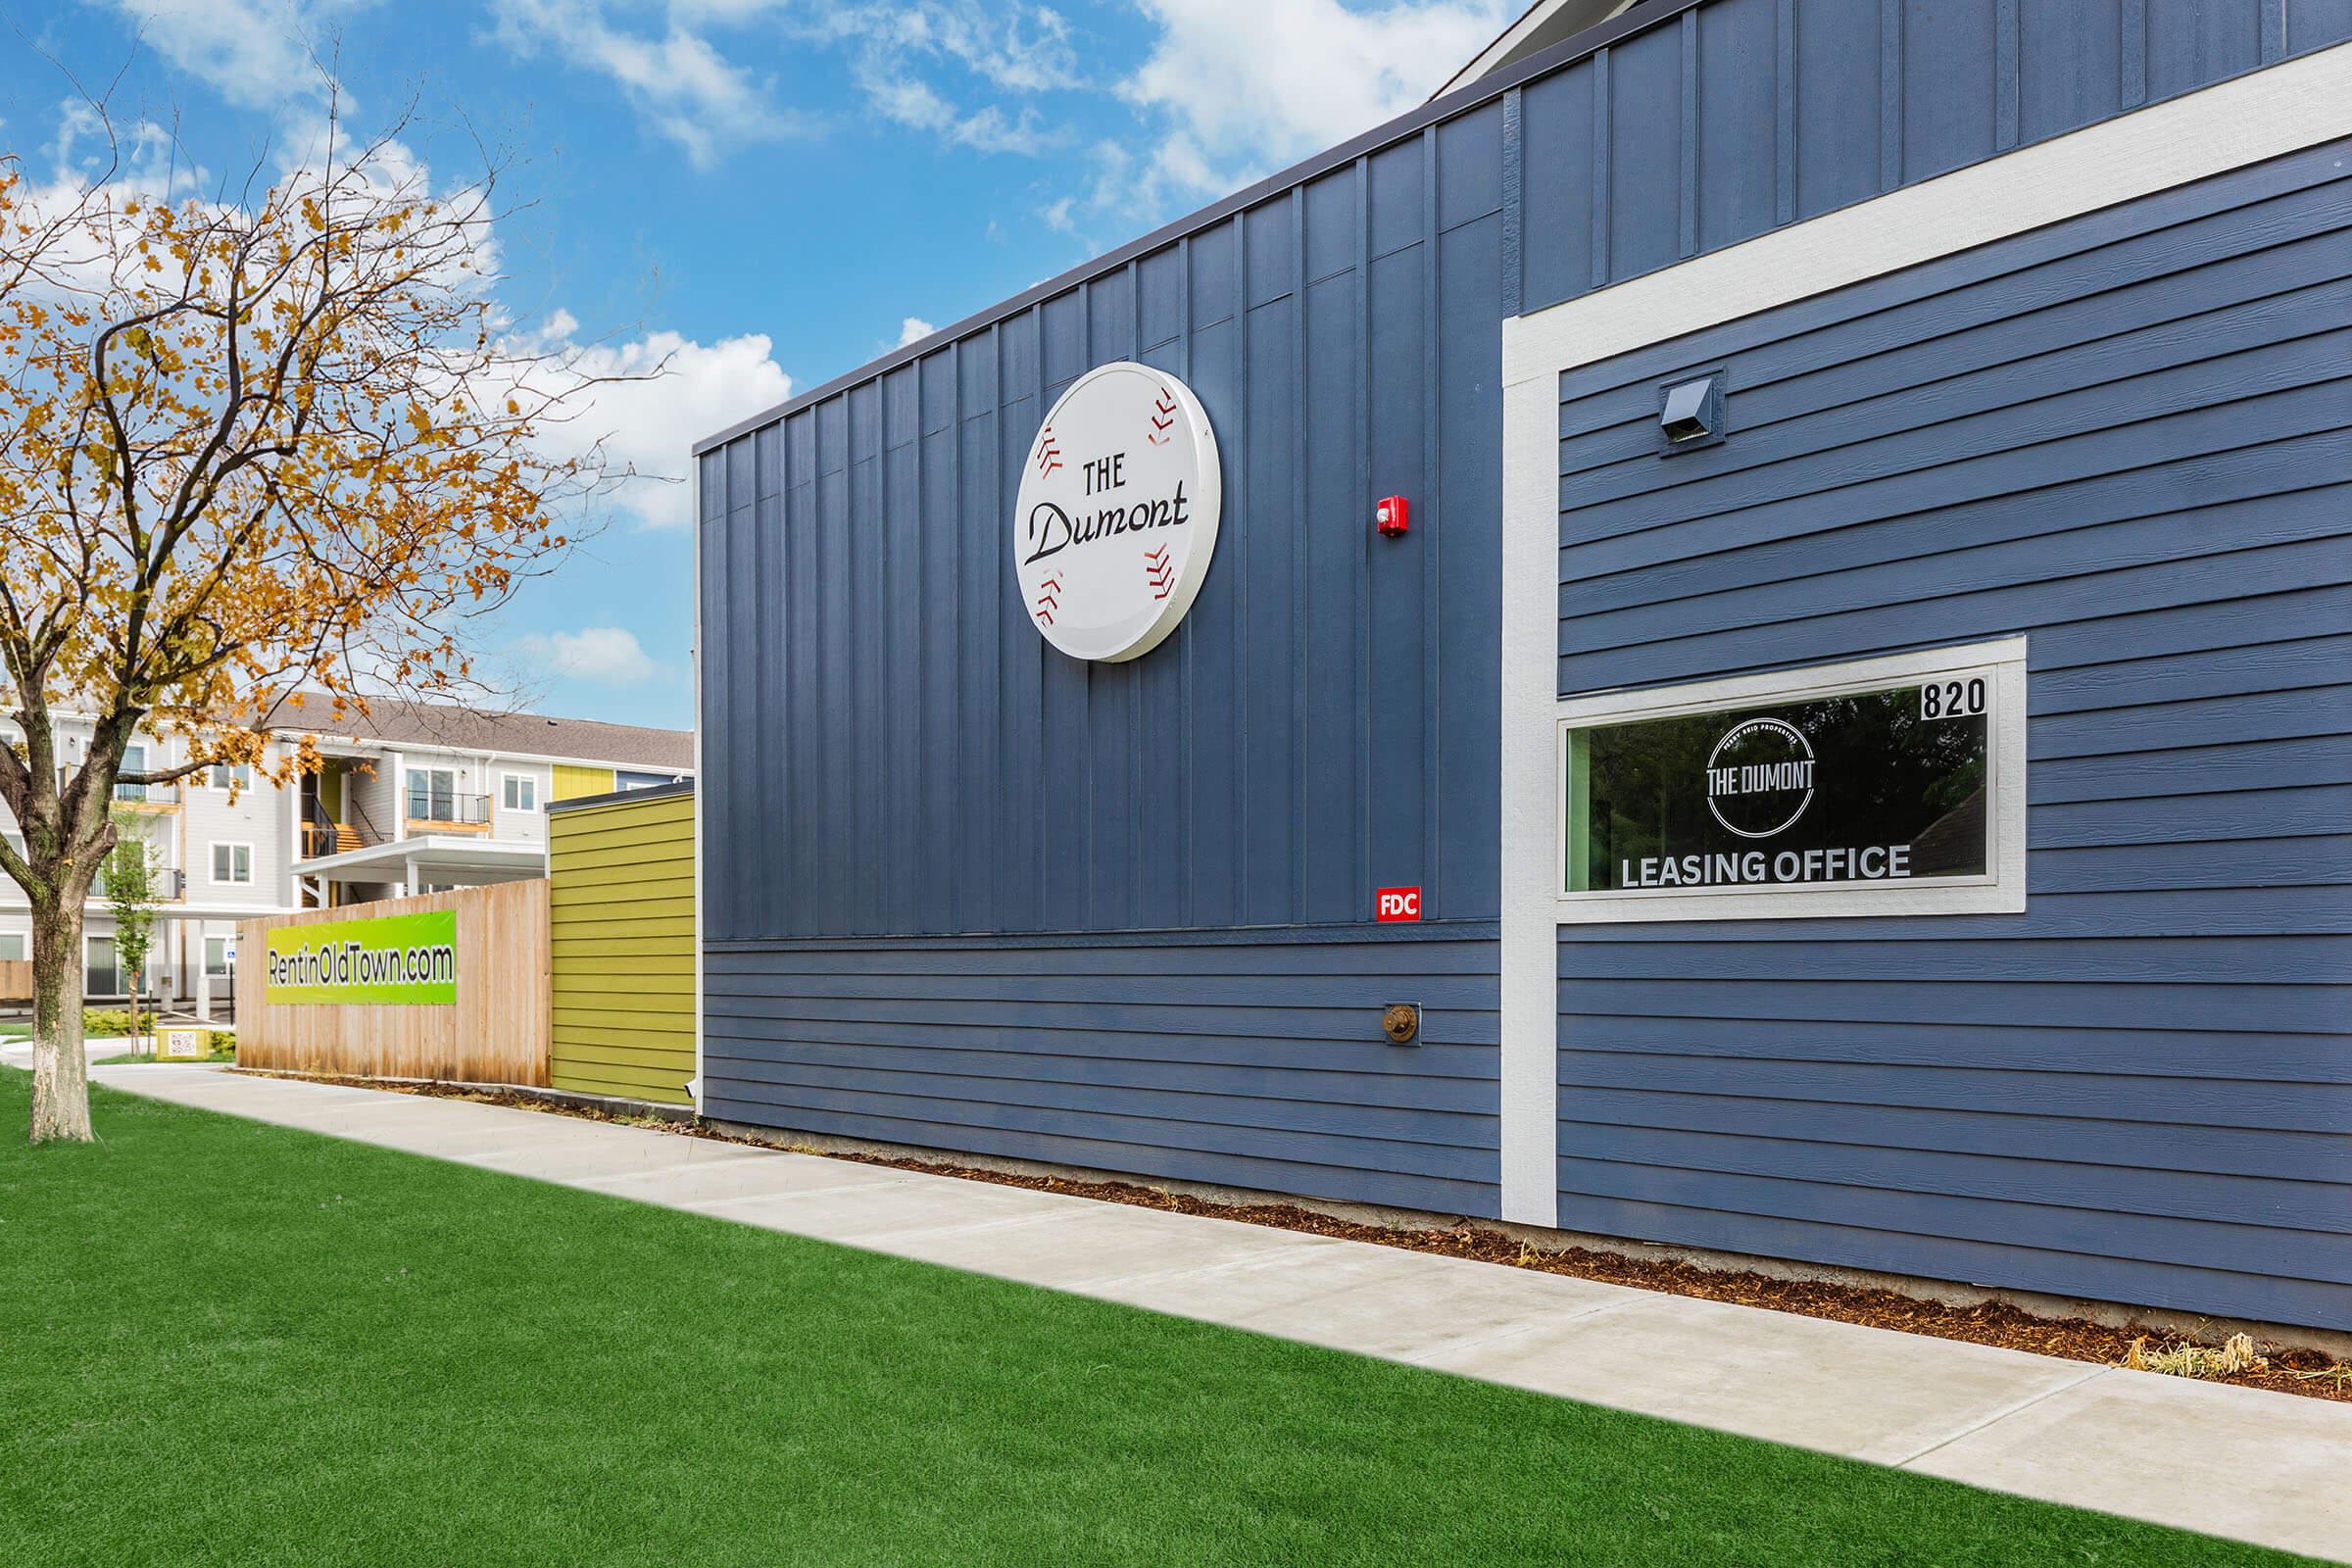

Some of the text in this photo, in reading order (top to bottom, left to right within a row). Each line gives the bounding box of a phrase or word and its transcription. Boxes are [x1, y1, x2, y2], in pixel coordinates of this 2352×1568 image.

[1083, 453, 1126, 496] THE
[1024, 479, 1189, 565] Dumont
[1924, 678, 1985, 718] 820
[1706, 760, 1815, 796] THE DUMONT
[1622, 845, 1910, 887] LEASING OFFICE
[1381, 893, 1417, 915] FDC
[269, 943, 453, 985] RentinOldTown.com
